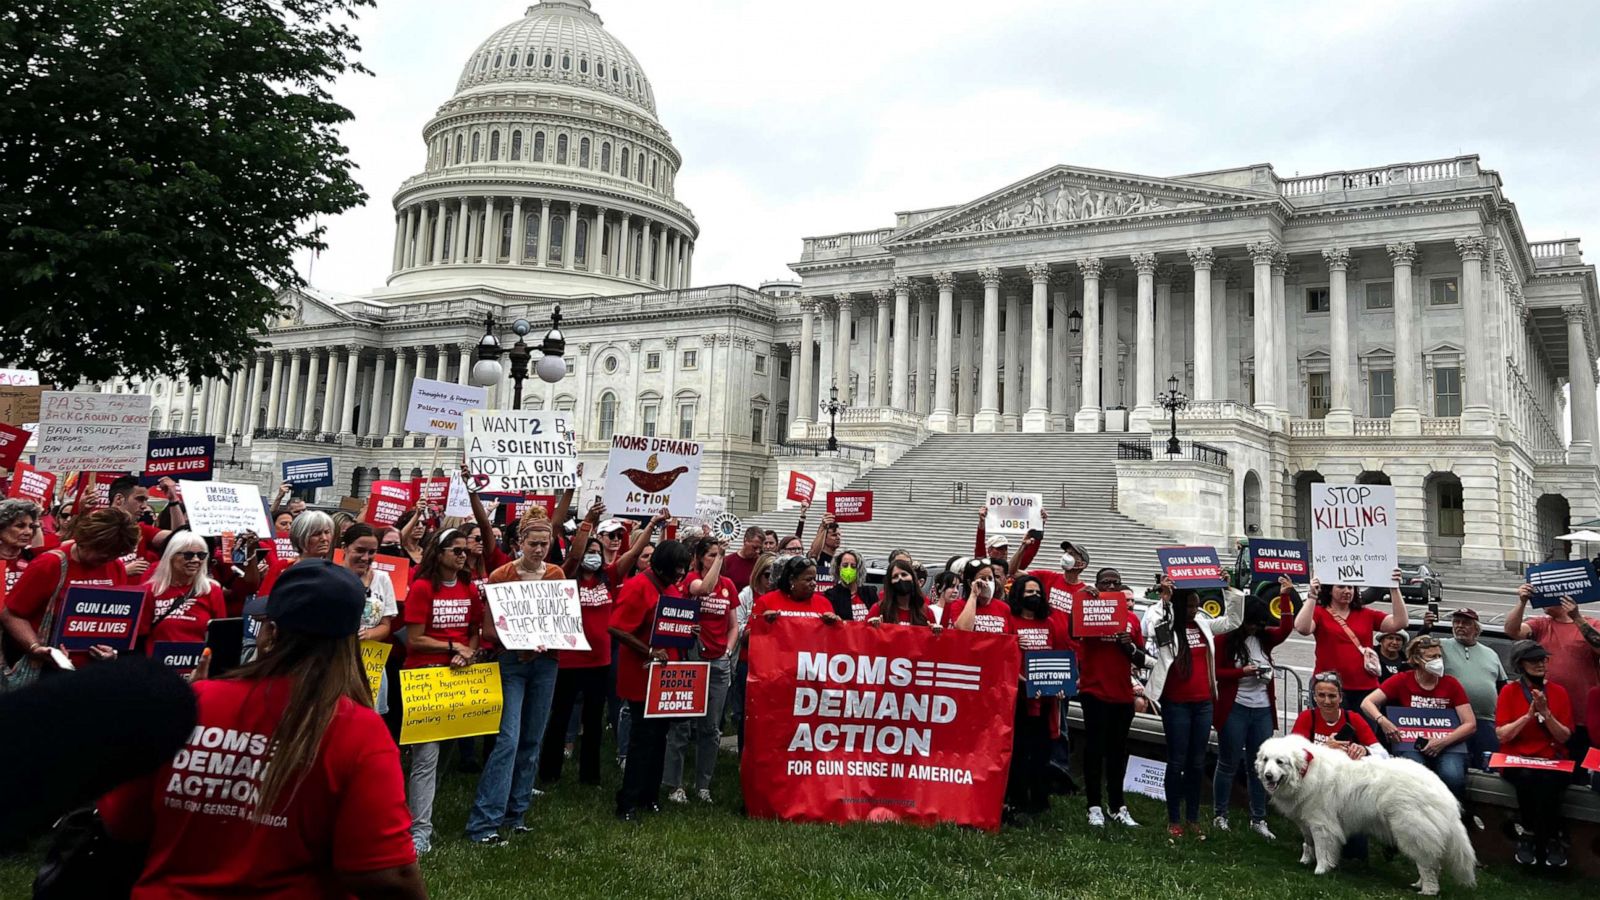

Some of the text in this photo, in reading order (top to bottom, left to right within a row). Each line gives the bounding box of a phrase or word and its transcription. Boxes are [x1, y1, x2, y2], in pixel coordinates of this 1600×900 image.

[48, 396, 97, 410] PASS
[417, 403, 440, 413] Policy
[45, 410, 118, 422] BACKGROUND
[47, 426, 71, 435] BAN
[76, 426, 122, 435] ASSAULT
[430, 420, 457, 431] NOW!
[470, 416, 474, 433] I
[470, 436, 482, 453] A
[612, 435, 699, 456] MOMS DEMAND
[151, 445, 206, 458] GUN LAWS
[148, 459, 206, 473] SAVE LIVES
[470, 458, 563, 476] NOT A GUN
[501, 473, 576, 490] STATISTIC!
[218, 487, 237, 496] HERE
[1324, 487, 1371, 506] STOP
[207, 494, 240, 503] BECAUSE
[626, 491, 670, 506] ACTION
[990, 496, 1033, 507] DO YOUR
[1314, 506, 1387, 530] KILLING
[1000, 520, 1030, 530] JOBS!
[1338, 528, 1364, 548] US!
[1258, 548, 1301, 558] GUN LAWS
[1168, 556, 1212, 565] GUN LAWS
[1258, 561, 1304, 572] SAVE LIVES
[1171, 567, 1217, 577] SAVE LIVES
[1338, 565, 1364, 580] NOW
[493, 586, 516, 602] I'M
[520, 582, 563, 600] MISSING
[1050, 593, 1073, 604] DEMAN
[75, 602, 131, 616] GUN LAWS
[433, 599, 459, 607] MOMS
[500, 598, 571, 617] SCHOOL BECAUSE
[433, 606, 469, 614] DEMAND
[662, 607, 695, 620] GUN LAWS
[433, 615, 465, 623] ACTION
[508, 615, 583, 634] THEY'RE MISSING
[68, 620, 128, 633] SAVE LIVES
[659, 622, 692, 634] SAVE LIVES
[164, 655, 192, 666] GUN
[402, 671, 431, 681] There
[450, 666, 492, 677] something
[661, 670, 697, 679] FOR THE
[796, 651, 913, 687] MOMS
[440, 676, 487, 688] hypocritical
[1029, 672, 1071, 681] EVERYTOWN
[660, 680, 692, 688] PEOPLE
[406, 691, 431, 703] about
[435, 690, 466, 701] praying
[470, 687, 481, 696] for
[661, 691, 693, 701] BY THE
[408, 697, 489, 717] problem you are
[658, 701, 694, 710] PEOPLE.
[793, 687, 957, 723] DEMAND
[1399, 717, 1452, 727] GUN LAWS
[787, 723, 932, 757] ACTION
[172, 749, 271, 781] DEMAN
[788, 760, 973, 785] FOR GUN SENSE IN AMERICA
[1141, 773, 1163, 782] EMAND
[203, 803, 238, 816] SENSE
